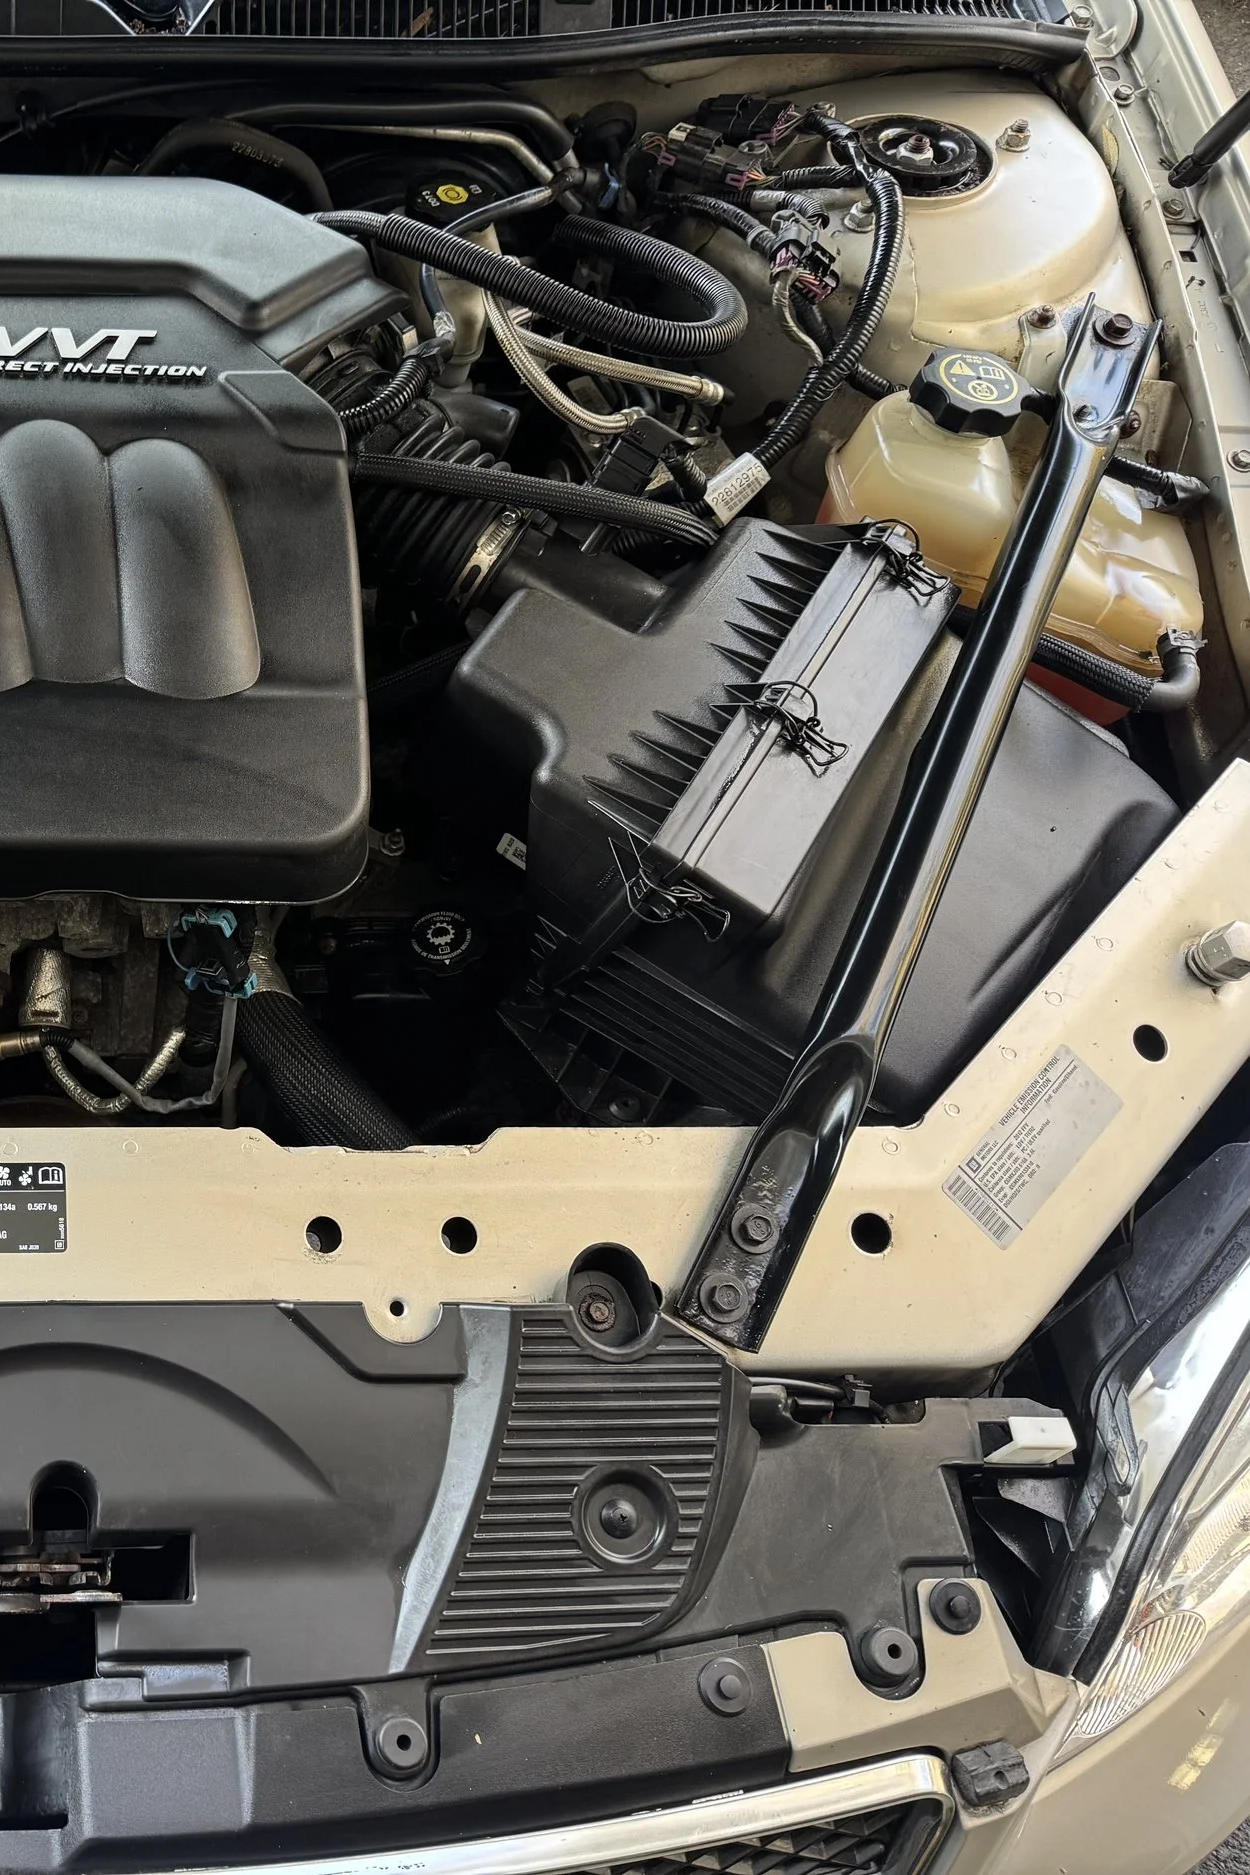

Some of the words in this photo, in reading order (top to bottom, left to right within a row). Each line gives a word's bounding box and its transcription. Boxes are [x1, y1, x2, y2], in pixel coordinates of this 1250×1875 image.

[63, 361, 208, 378] INJECTION
[711, 462, 763, 506] 22812975
[998, 1102, 1019, 1127] VEHICLE
[1016, 1078, 1040, 1105] EMISSION
[1037, 1054, 1060, 1080] CONTROL
[1019, 1076, 1051, 1114] INFORMATION
[28, 1203, 47, 1211] 0.567
[48, 1203, 58, 1212] kg
